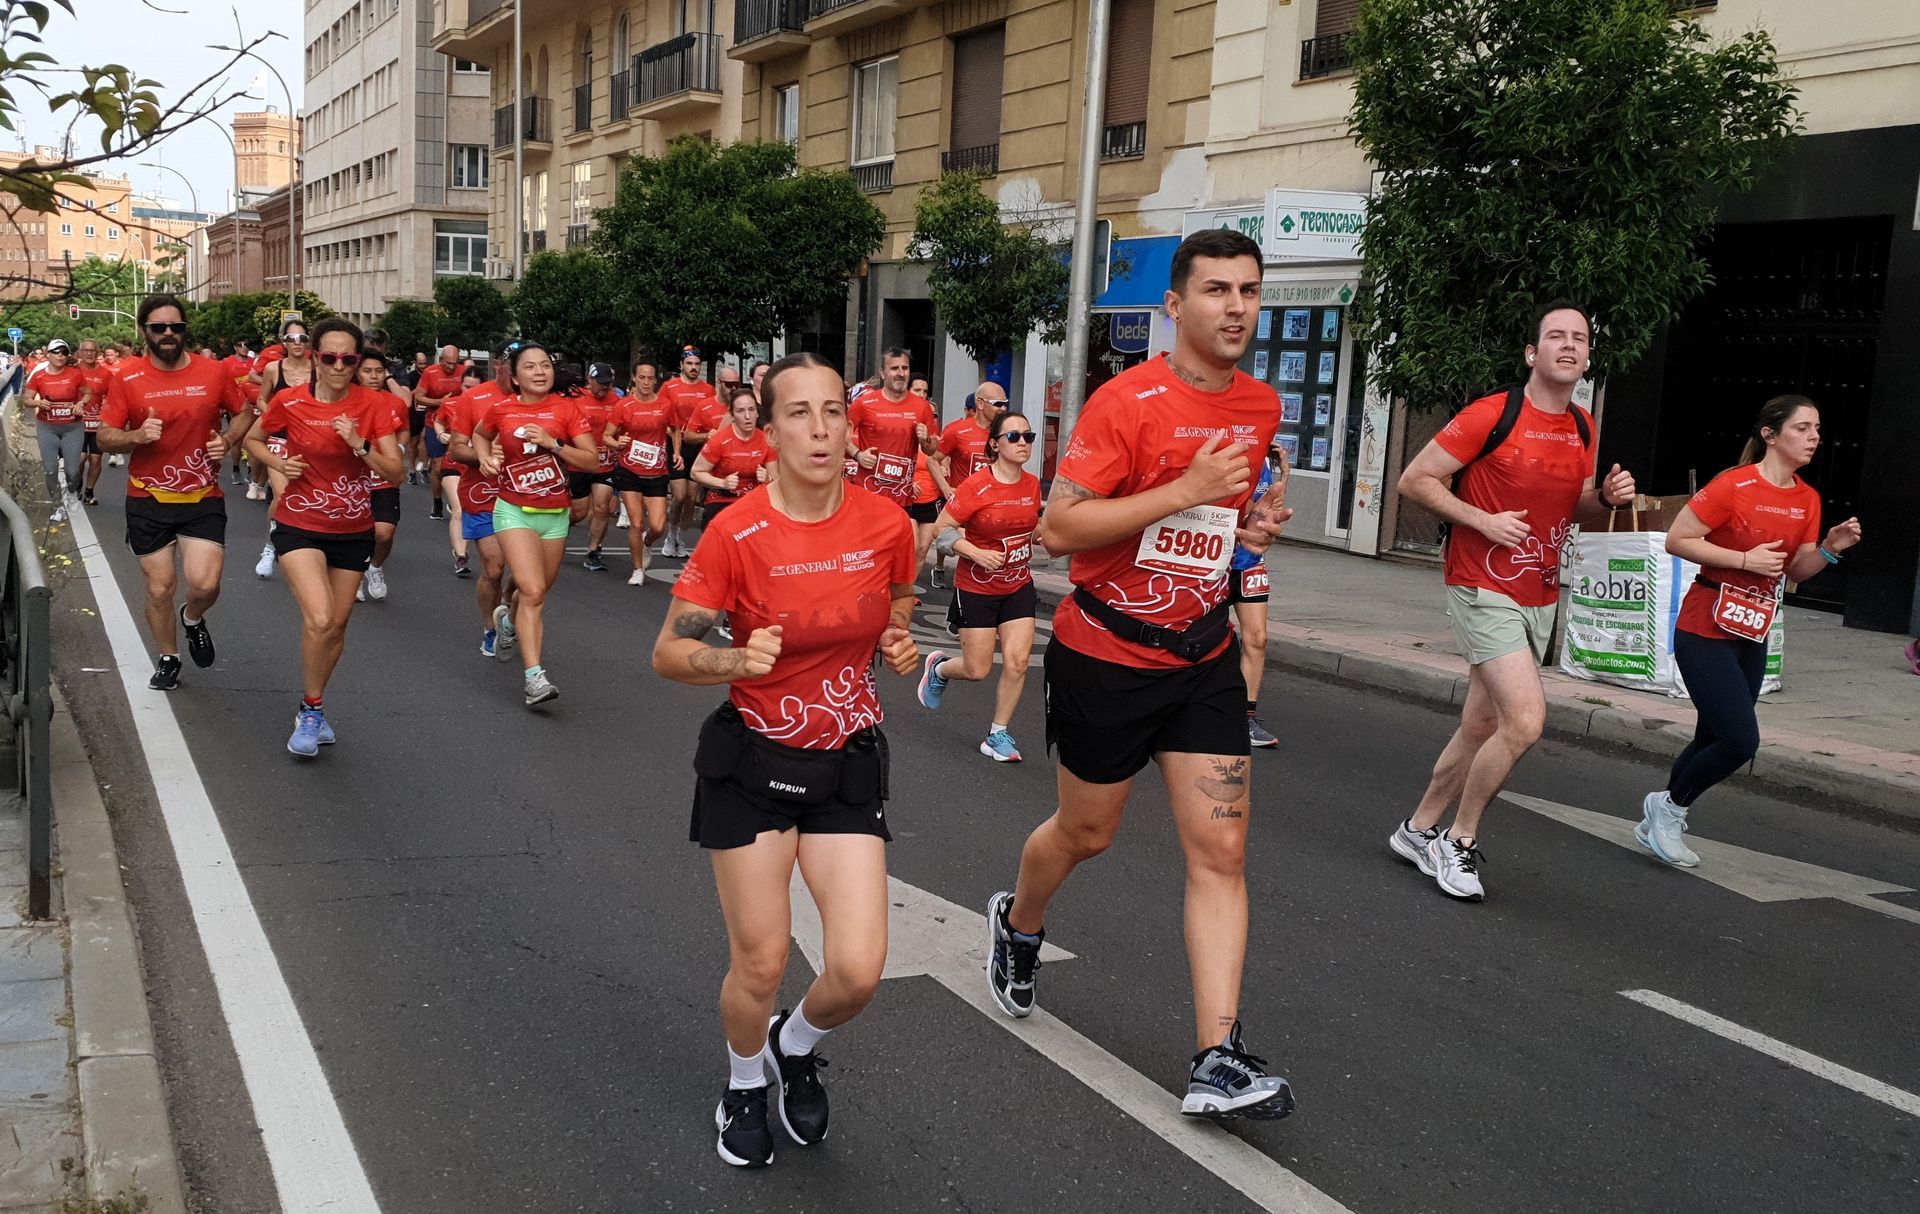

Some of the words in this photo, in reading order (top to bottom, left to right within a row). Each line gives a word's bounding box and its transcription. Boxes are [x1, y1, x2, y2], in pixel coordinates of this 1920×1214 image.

[1300, 211, 1363, 234] TECNOCASA
[1296, 288, 1309, 300] 910
[1310, 287, 1321, 300] 188
[1322, 287, 1335, 300] 017
[633, 448, 655, 461] 5483
[518, 466, 556, 488] 2260
[883, 463, 903, 477] 808
[733, 523, 760, 542] luanvi
[1155, 526, 1224, 562] 5980
[786, 559, 838, 575] GENERALI
[842, 553, 858, 562] 10K
[843, 561, 875, 572] INCLUSION
[1594, 574, 1646, 600] obra
[1596, 619, 1604, 628] DE
[1605, 620, 1645, 631] ESCOMBROS
[1722, 602, 1767, 630] 2536
[769, 780, 807, 794] KIPRUN
